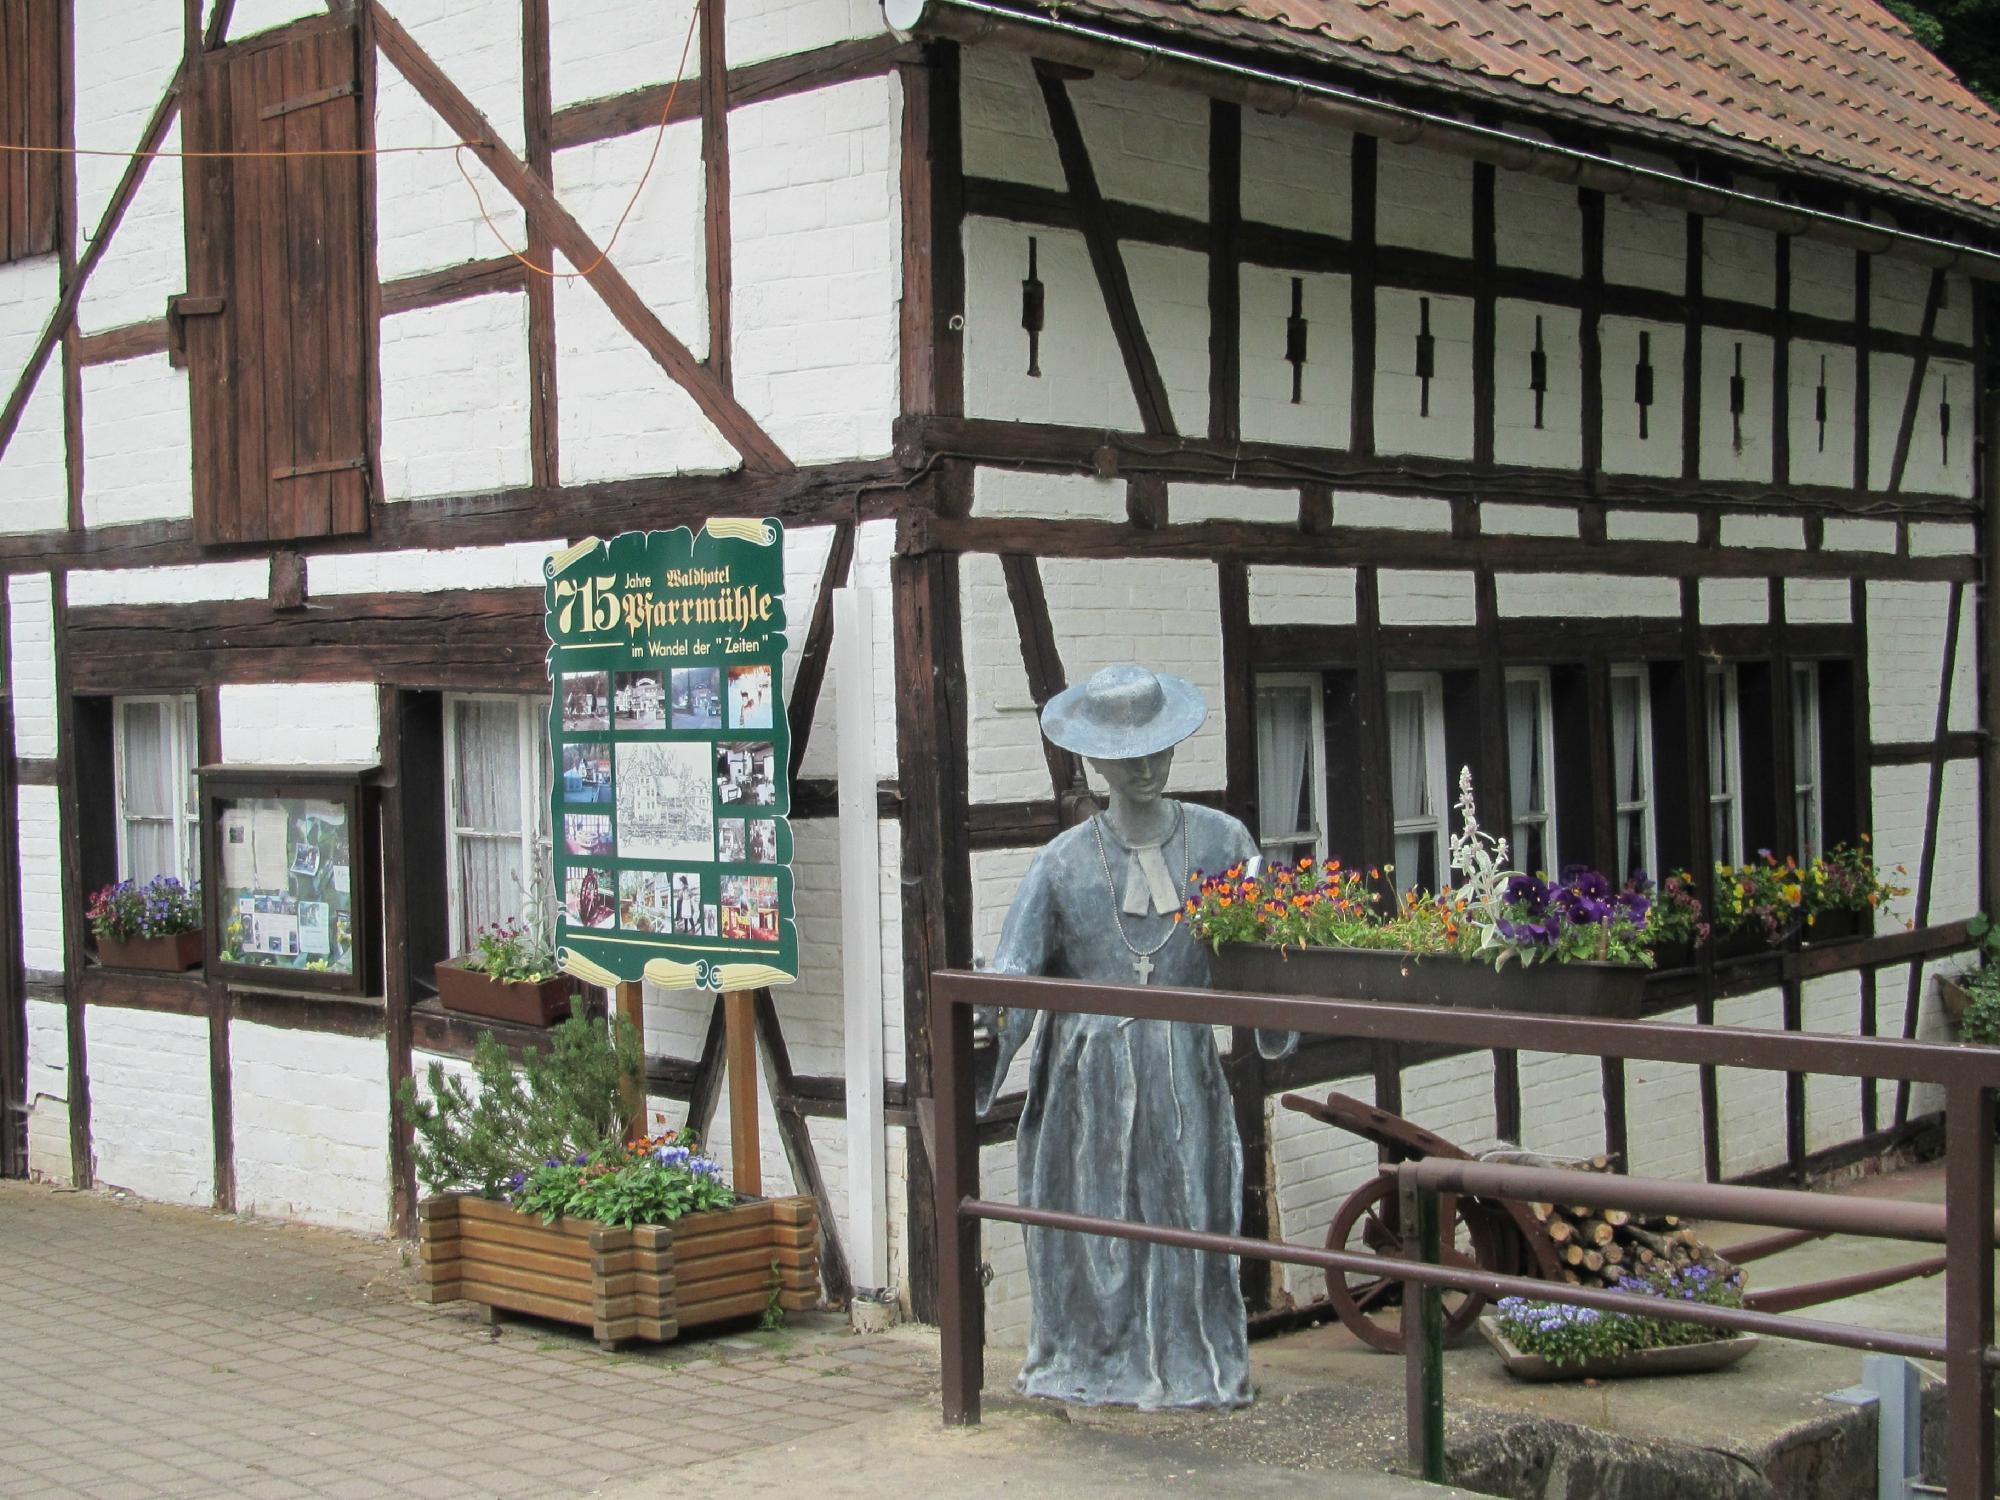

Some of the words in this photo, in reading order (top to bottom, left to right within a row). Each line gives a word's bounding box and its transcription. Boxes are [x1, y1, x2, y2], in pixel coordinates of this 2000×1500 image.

[666, 565, 730, 590] Waldhotel
[555, 573, 621, 634] 715
[624, 573, 651, 589] Jahre
[622, 585, 773, 638] Pfarrmühle
[631, 645, 644, 658] im
[648, 642, 688, 657] Wandel
[693, 641, 711, 655] der
